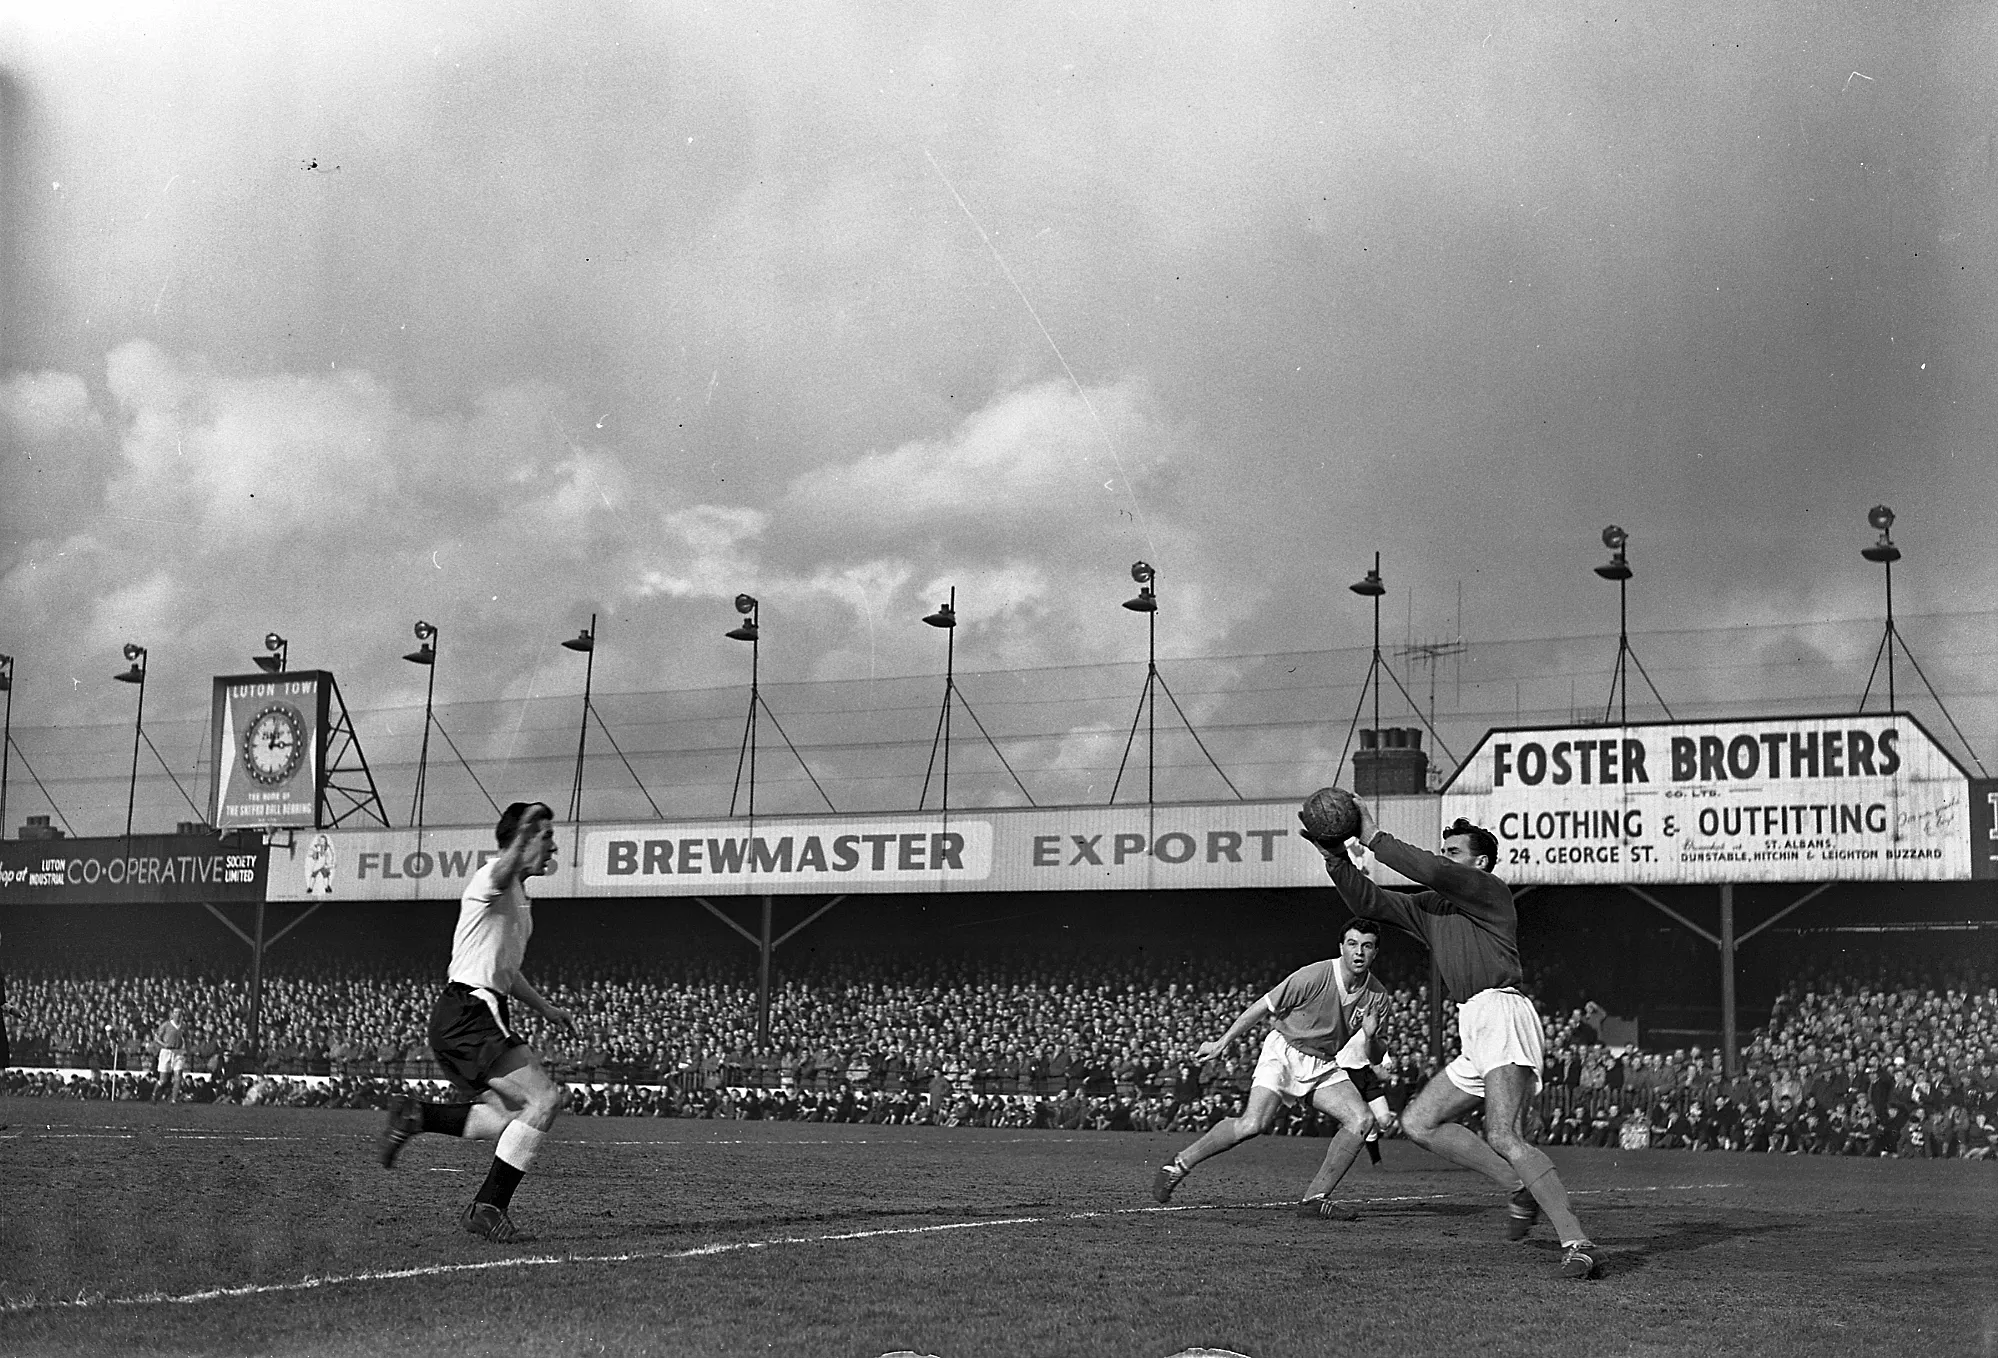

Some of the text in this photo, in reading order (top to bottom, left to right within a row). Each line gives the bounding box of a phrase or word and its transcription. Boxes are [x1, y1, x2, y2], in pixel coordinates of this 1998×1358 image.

[233, 683, 275, 698] LUTON
[1493, 730, 1901, 788] FOSTER BROTHERS
[1499, 809, 1643, 840] CLOTHING
[1662, 815, 1681, 837] &
[1699, 803, 1887, 837] OUTFITTING
[607, 832, 965, 876] BREWMASTER
[1032, 829, 1289, 867] EXPORT
[1545, 846, 1620, 864] GEORGE
[1630, 845, 1659, 863] ST.
[1822, 849, 1878, 861] LEIGHTON
[1886, 848, 1942, 860] BUZZARD
[41, 859, 66, 872] LUTON
[226, 855, 257, 868] SOCIETY
[15, 867, 28, 883] at
[29, 873, 65, 886] INDUSTRIAL
[225, 869, 255, 883] LIMITED
